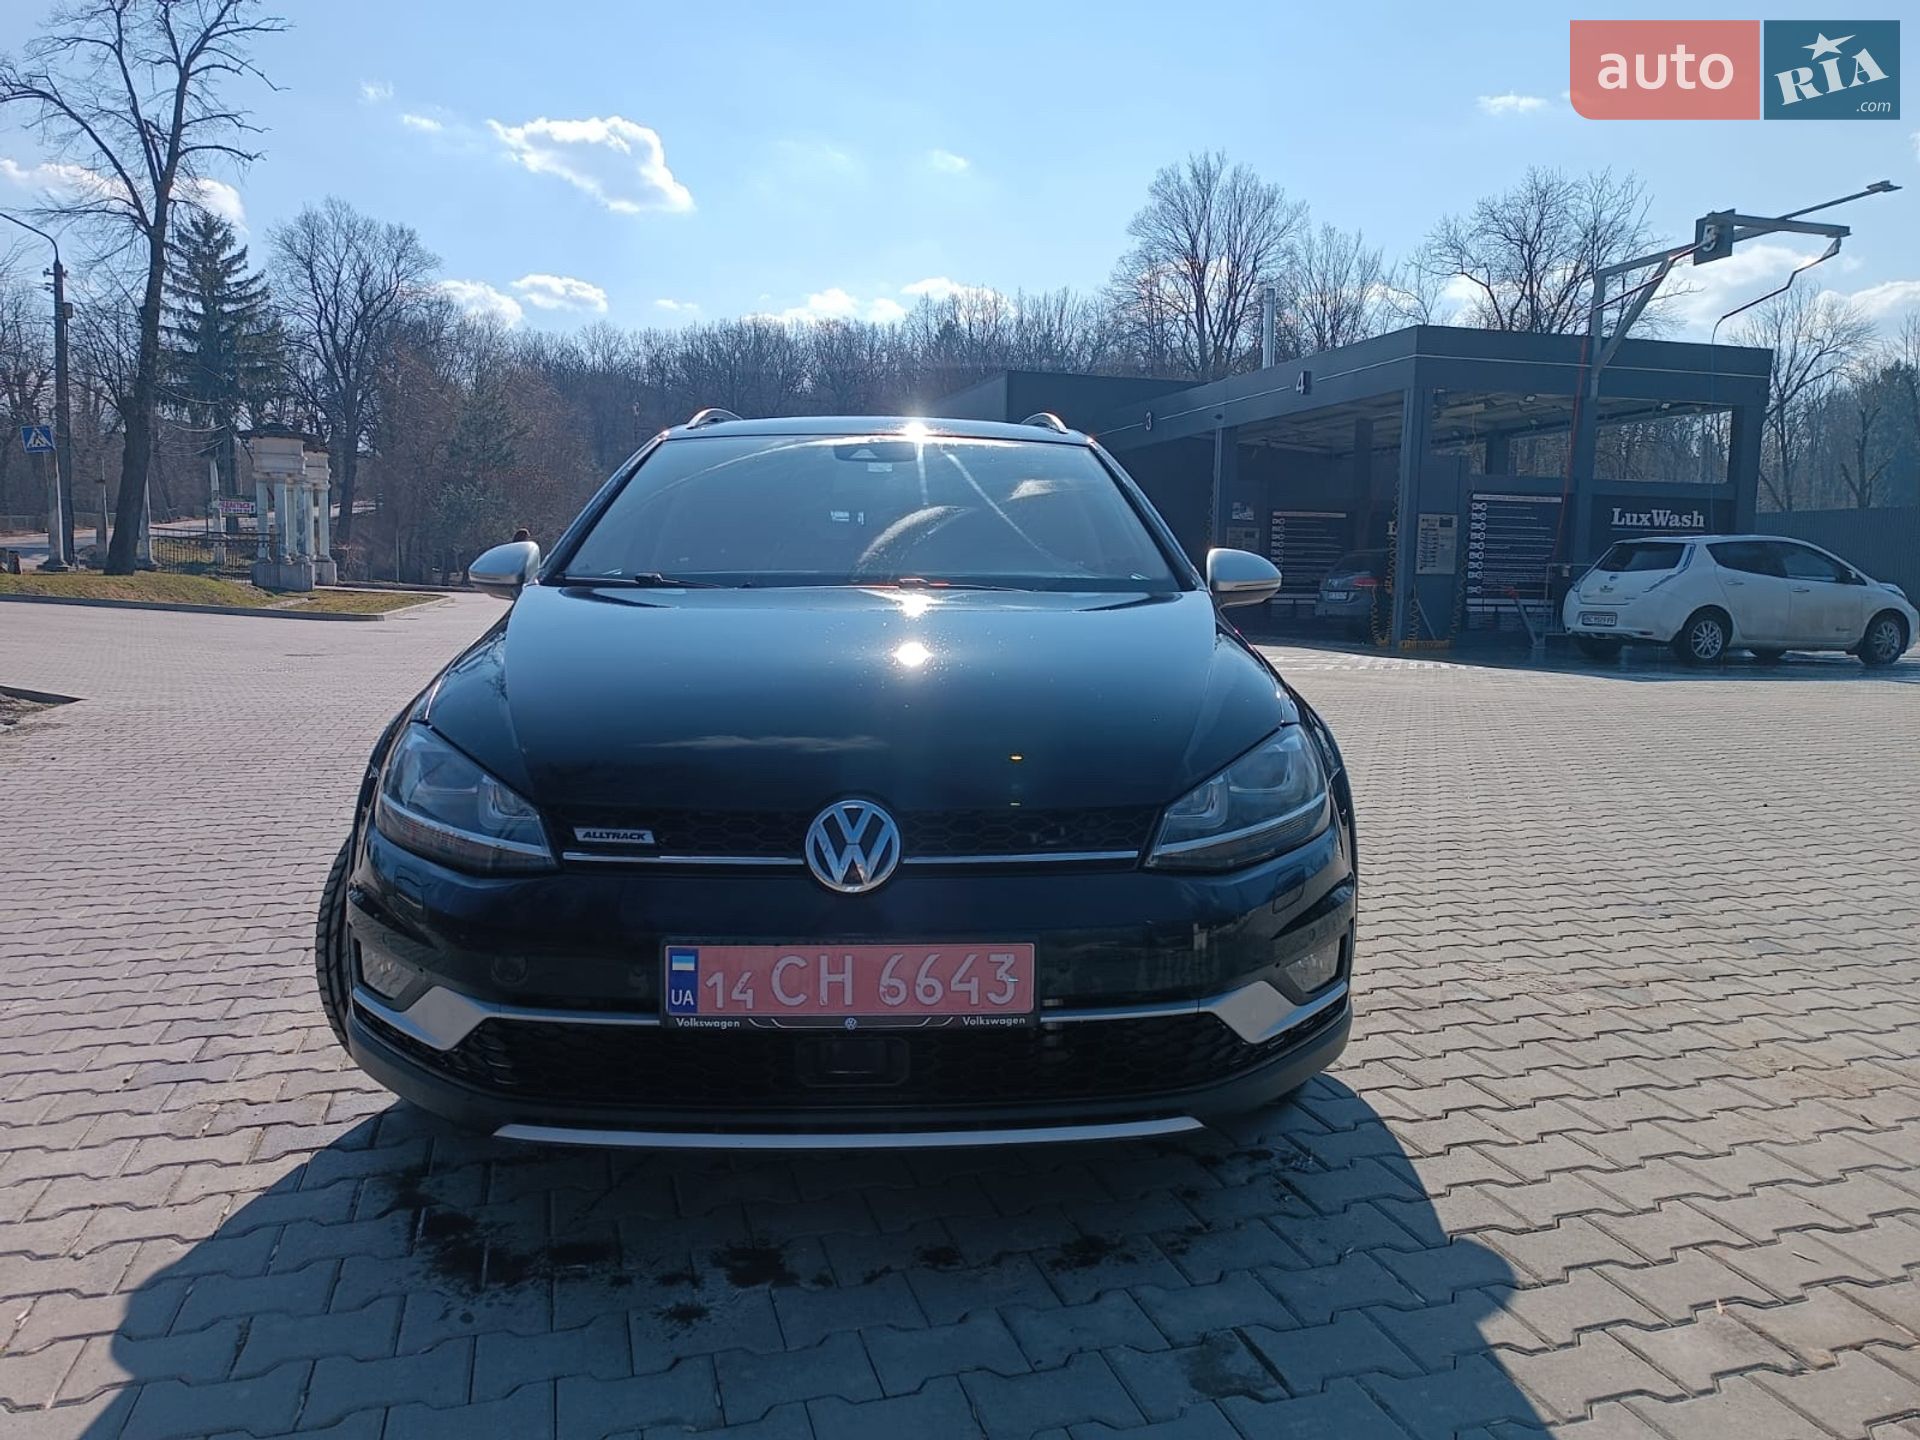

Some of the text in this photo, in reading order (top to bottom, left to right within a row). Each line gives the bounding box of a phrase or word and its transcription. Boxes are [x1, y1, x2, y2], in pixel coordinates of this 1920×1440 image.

[1611, 507, 1705, 527] LuxWash
[583, 831, 646, 840] ALLTRACK
[705, 953, 1016, 1009] 14 CH 6643
[671, 989, 695, 1005] UA
[676, 1018, 741, 1029] Volkswagen
[963, 1016, 1026, 1027] Volkswagen
